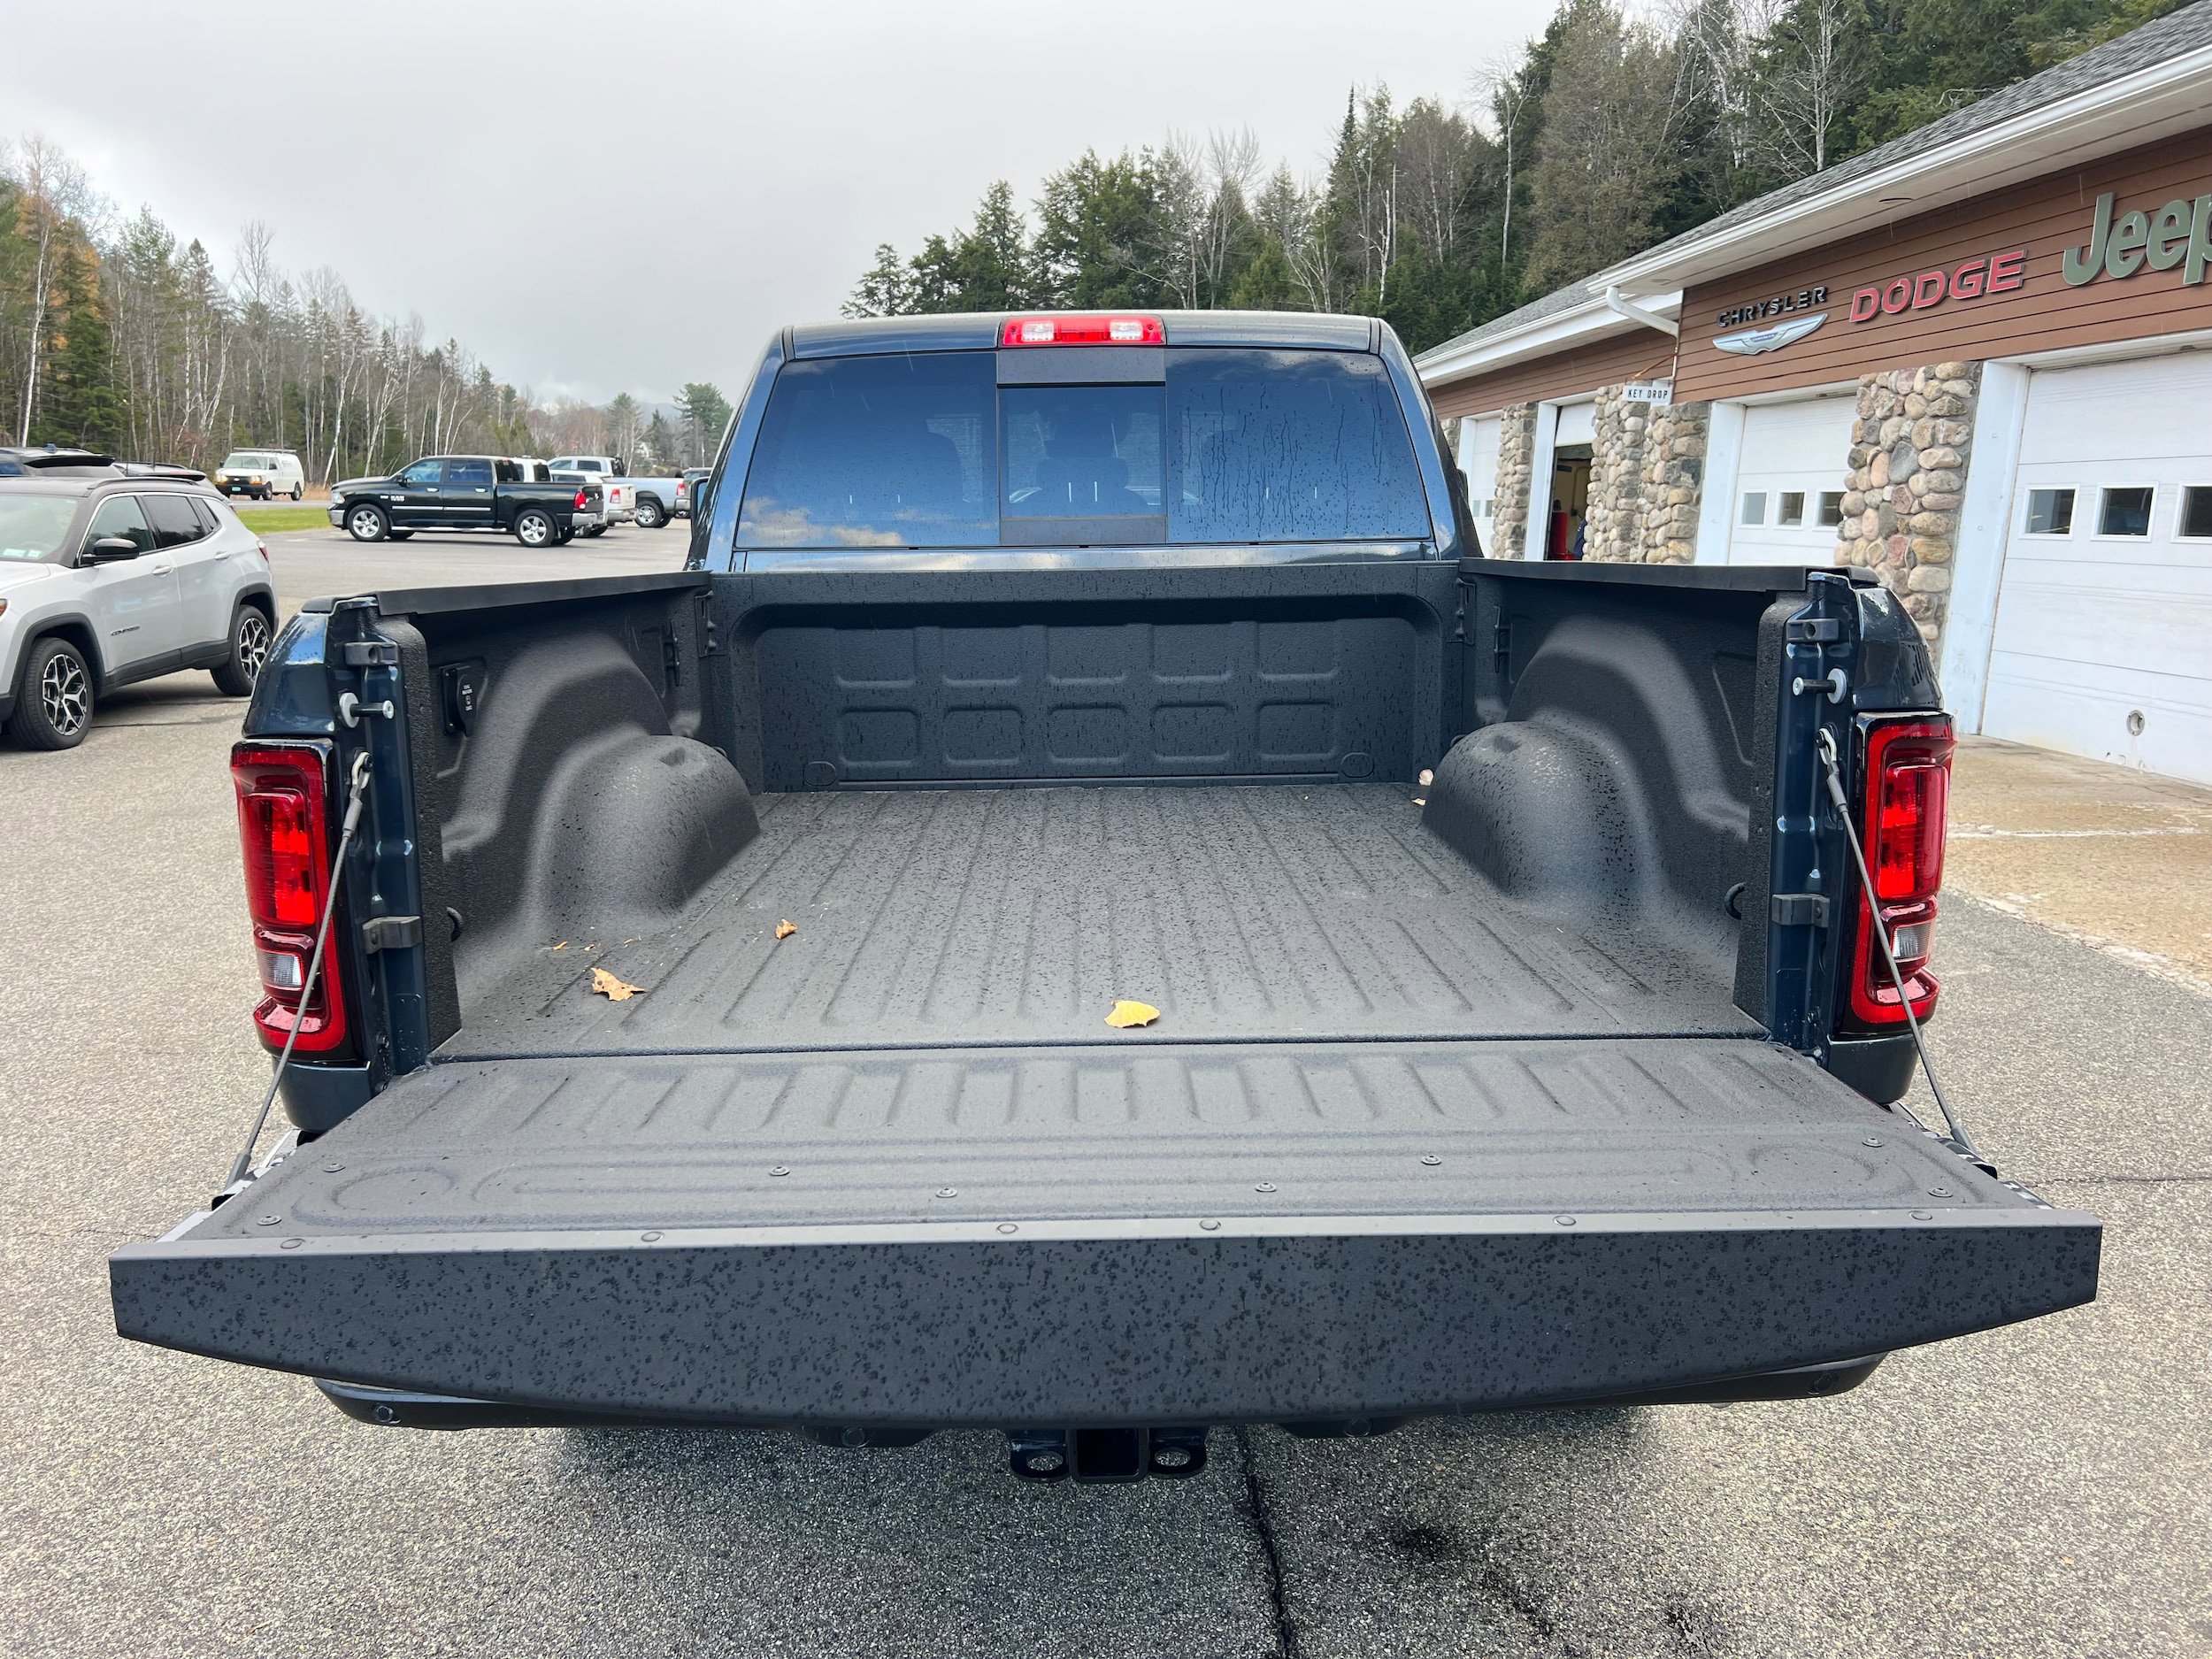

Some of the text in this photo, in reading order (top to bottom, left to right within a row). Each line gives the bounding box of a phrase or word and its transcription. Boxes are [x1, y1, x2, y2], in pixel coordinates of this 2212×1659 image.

[2062, 192, 2212, 287] Jeep
[1717, 286, 1828, 327] CHRYSLER
[1848, 250, 2027, 324] DODGE
[1627, 388, 1668, 398] KEY DROP
